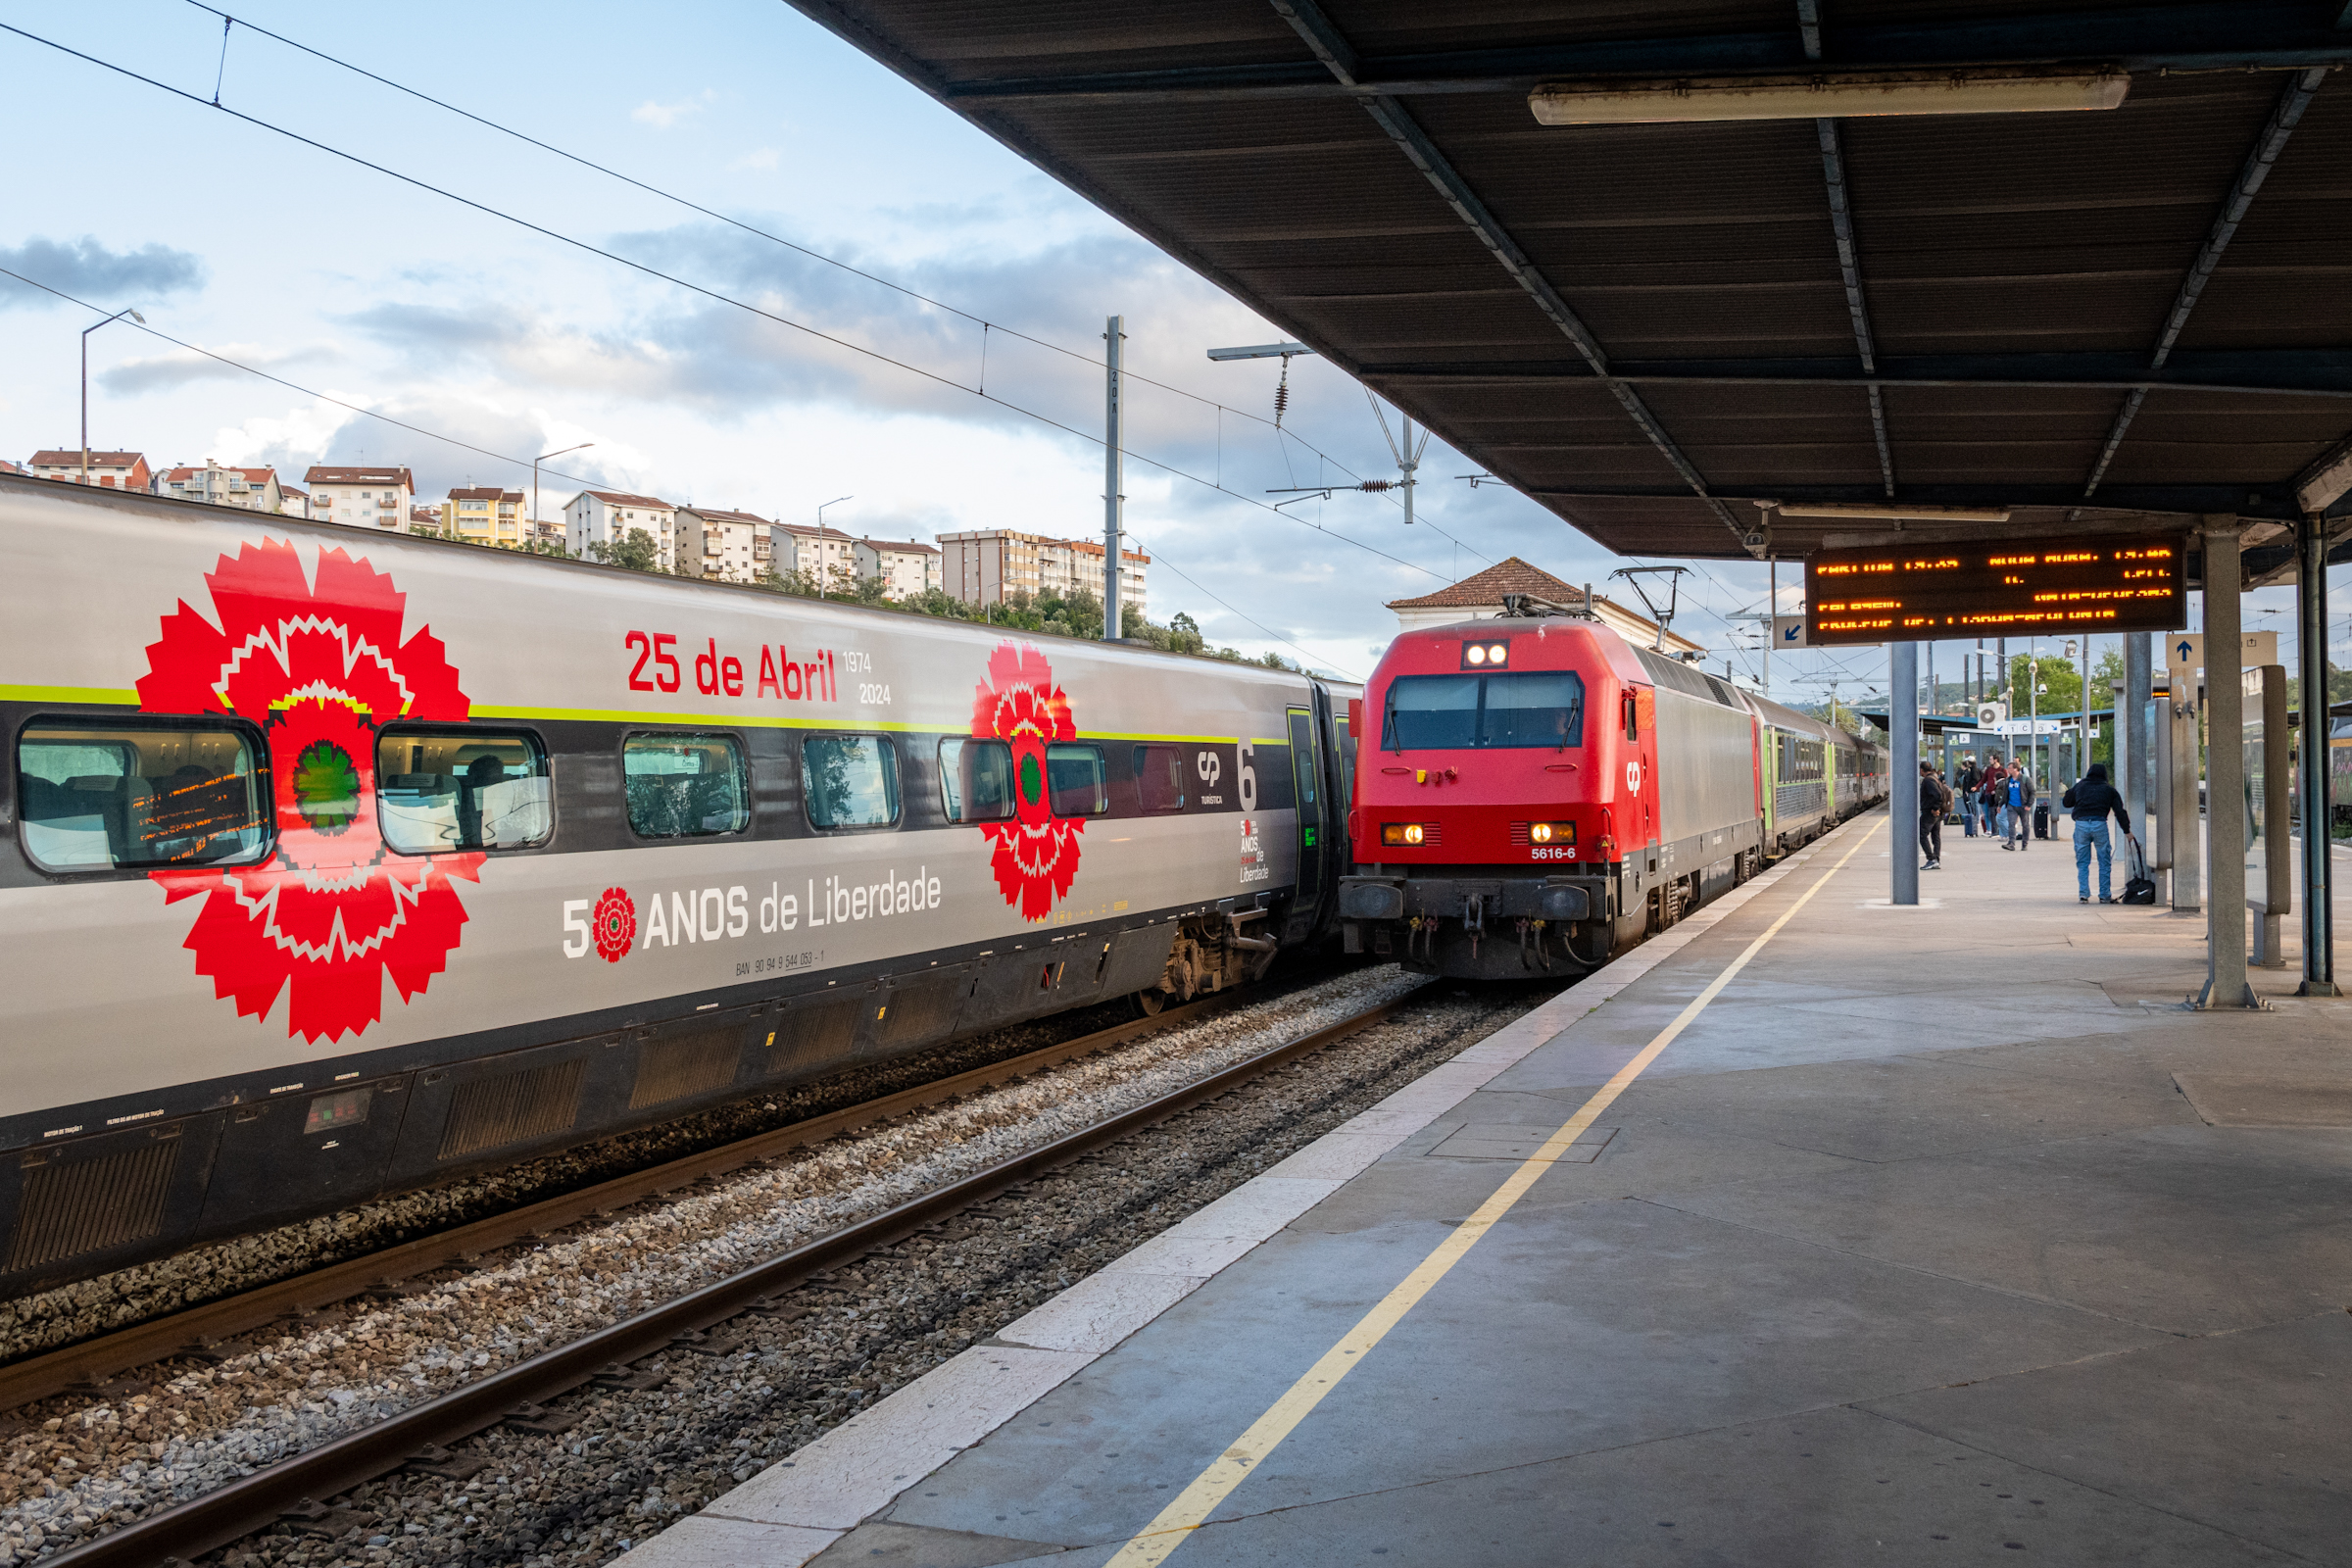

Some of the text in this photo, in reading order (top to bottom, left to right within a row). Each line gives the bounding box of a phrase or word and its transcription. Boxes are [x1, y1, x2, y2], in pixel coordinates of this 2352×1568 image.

[624, 630, 837, 703] 25 de Abril
[842, 651, 872, 673] 1974
[858, 684, 892, 705] 2024
[1236, 736, 1257, 812] 6
[1200, 794, 1223, 805] TURÍSTICA
[1241, 836, 1258, 853] ANOS
[1256, 847, 1264, 862] de
[1531, 847, 1576, 859] 5616-6
[1240, 863, 1269, 883] Liberdade
[642, 885, 749, 950] ANOS
[760, 882, 798, 934] de
[808, 865, 941, 928] Liberdade
[736, 961, 751, 976] BAN
[756, 959, 764, 973] 90
[766, 957, 775, 971] 94
[778, 956, 783, 969] 9
[785, 954, 798, 968] 544
[800, 952, 812, 965] 053
